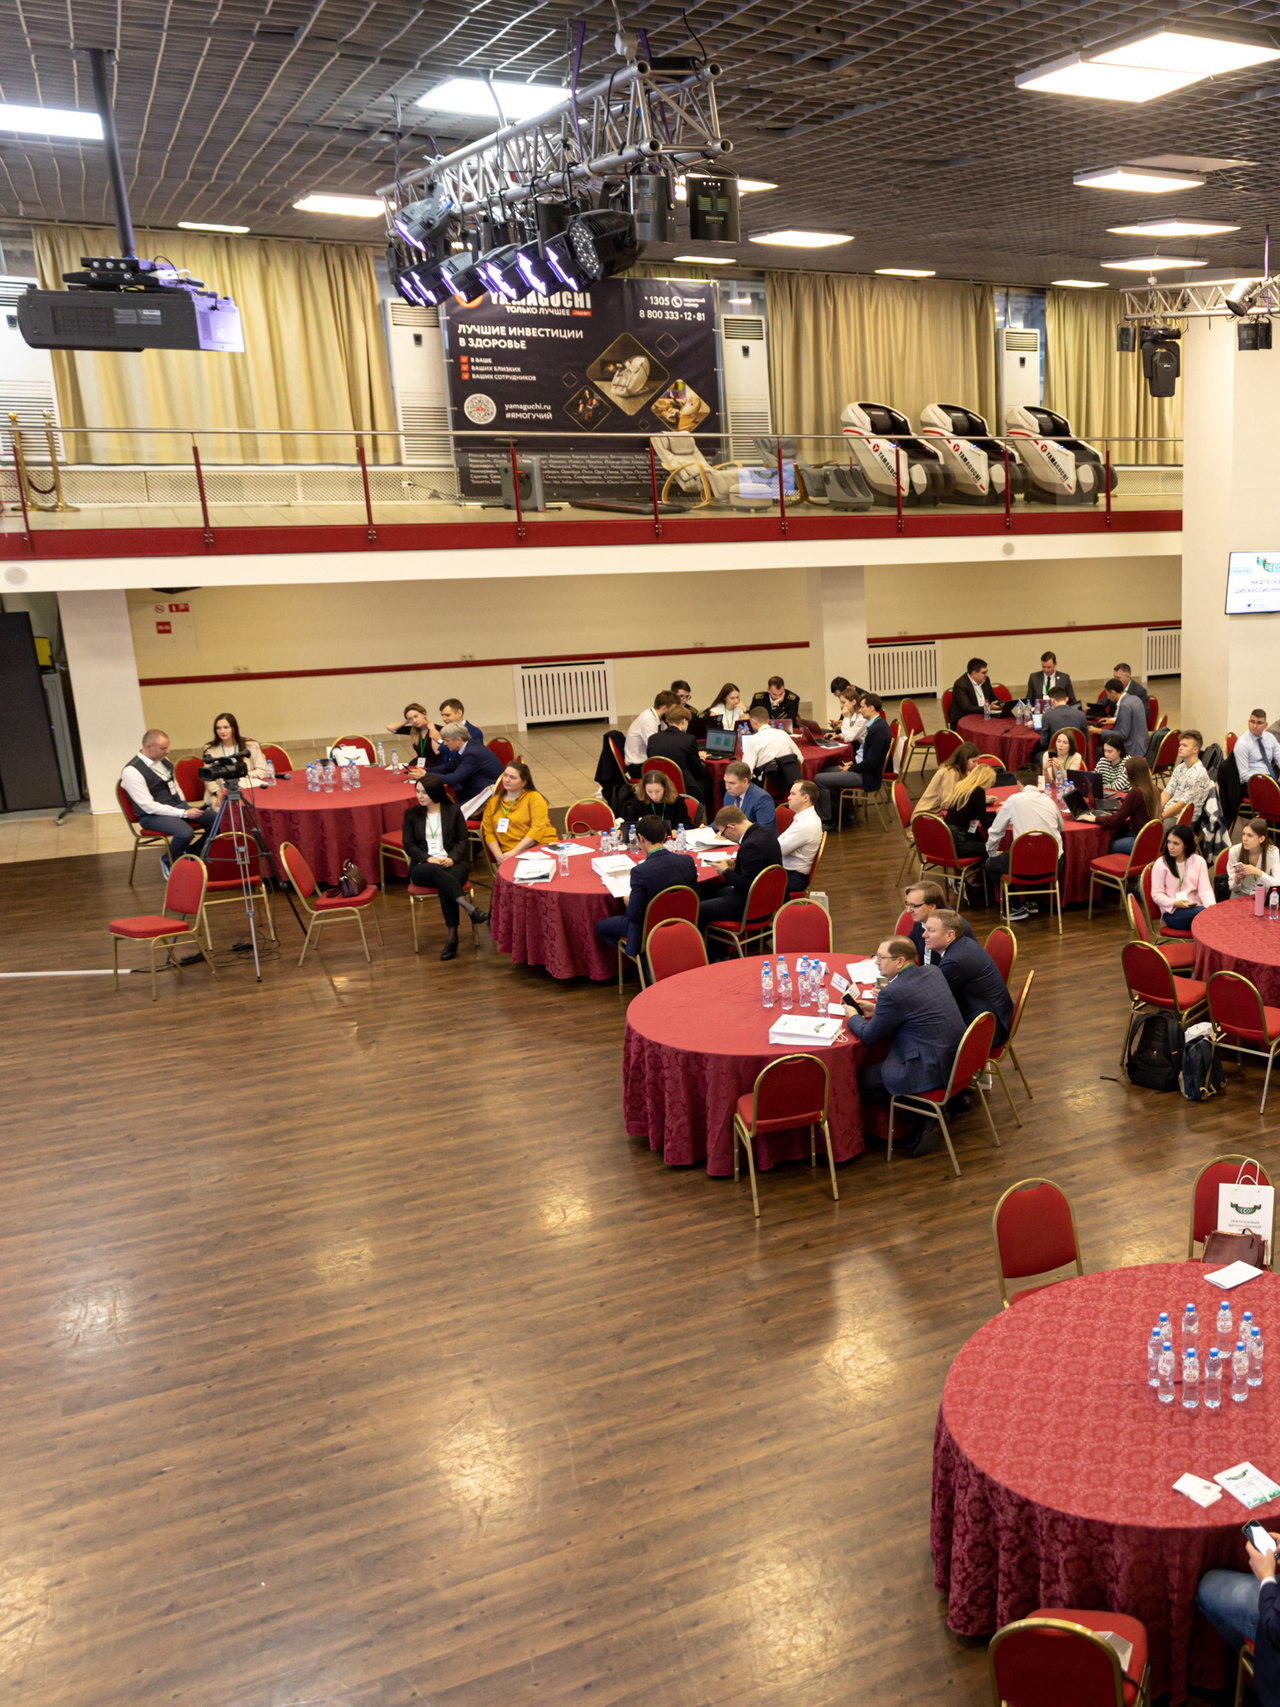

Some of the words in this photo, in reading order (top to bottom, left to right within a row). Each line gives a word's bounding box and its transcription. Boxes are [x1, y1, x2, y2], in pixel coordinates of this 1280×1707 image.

[505, 305, 538, 315] ТОЛЬКО
[539, 307, 571, 316] ЛУЧШЕЕ
[639, 309, 645, 318] 8
[647, 310, 663, 319] 800
[457, 324, 507, 336] ЛУЧШИЕ
[508, 326, 584, 339] ИНВЕСТИЦИИ
[458, 338, 466, 347] В
[468, 338, 527, 349] ЗДОРОВЬЕ
[504, 403, 551, 411] yamaguchi.ru
[505, 412, 553, 420] #ЯМОГУЧИЙ
[958, 451, 982, 481] YAMAGUCHI
[1046, 451, 1069, 481] YAMAGUCHI
